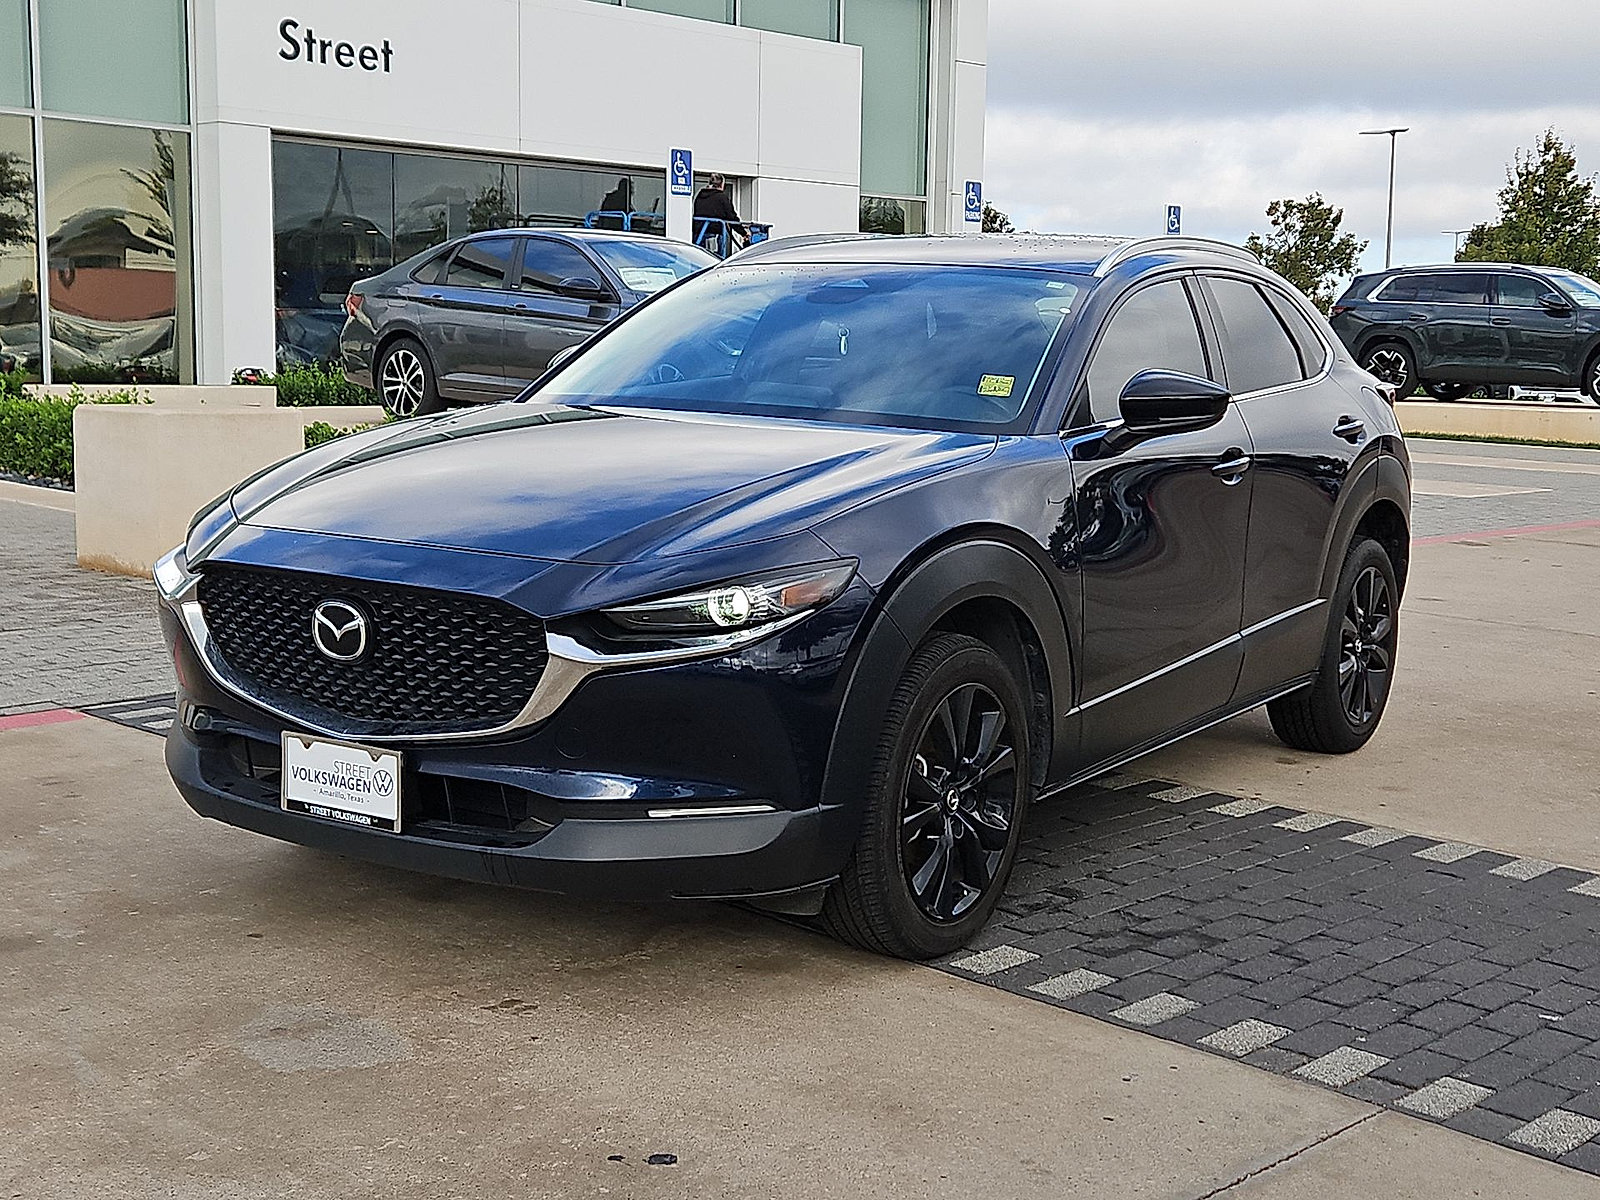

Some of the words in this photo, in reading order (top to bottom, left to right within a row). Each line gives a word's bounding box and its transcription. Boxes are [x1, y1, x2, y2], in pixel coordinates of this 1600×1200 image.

[278, 18, 394, 73] Street
[291, 765, 371, 793] VOLKSWAGEN
[333, 760, 371, 779] STREET
[346, 793, 364, 804] Texas
[309, 804, 331, 817] STREET
